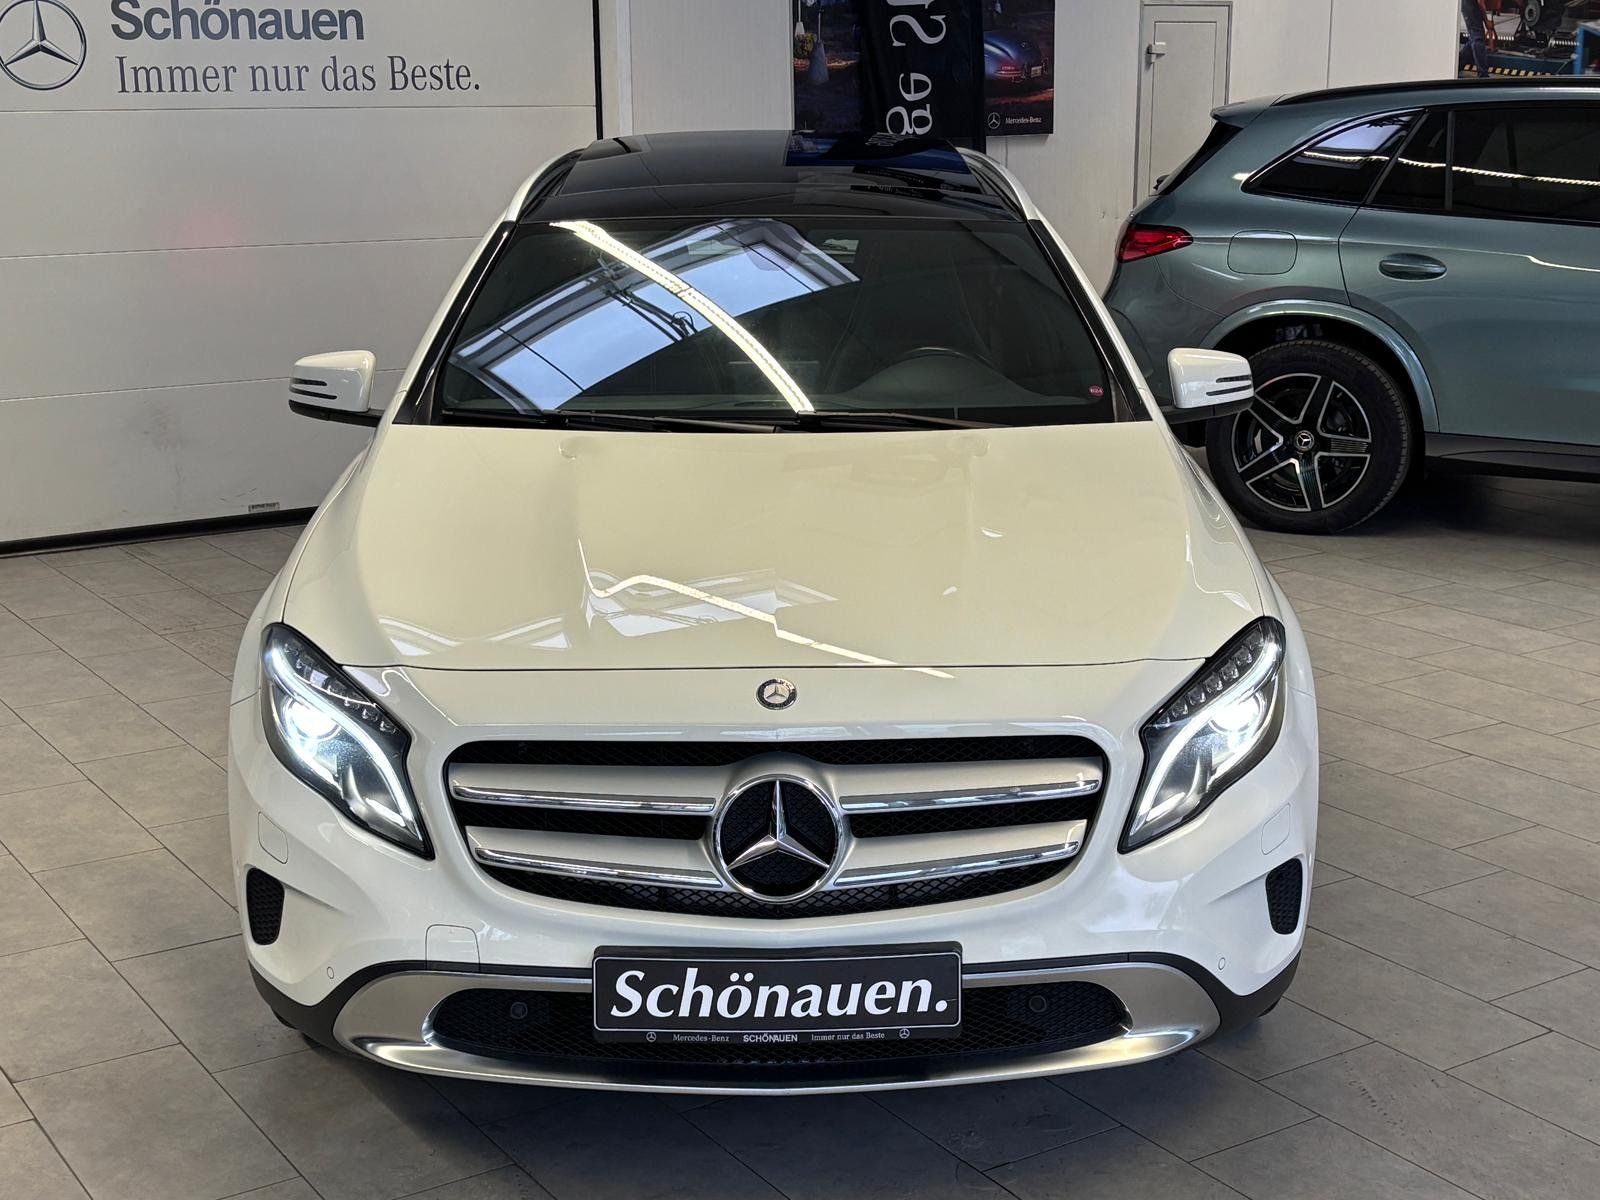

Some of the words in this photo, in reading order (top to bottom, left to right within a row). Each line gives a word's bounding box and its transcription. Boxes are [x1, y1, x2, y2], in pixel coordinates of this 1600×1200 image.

[110, 0, 365, 41] Schönauen
[115, 56, 237, 93] Immer
[248, 65, 310, 92] nur
[321, 56, 377, 92] das
[387, 55, 480, 91] Beste.
[1005, 116, 1042, 124] Mercedes-Benz
[610, 967, 948, 1019] Schönauen.
[743, 1033, 798, 1043] SCHÖNAUEN
[836, 1033, 851, 1041] nur
[851, 1031, 864, 1040] das
[865, 1031, 885, 1039] Beste
